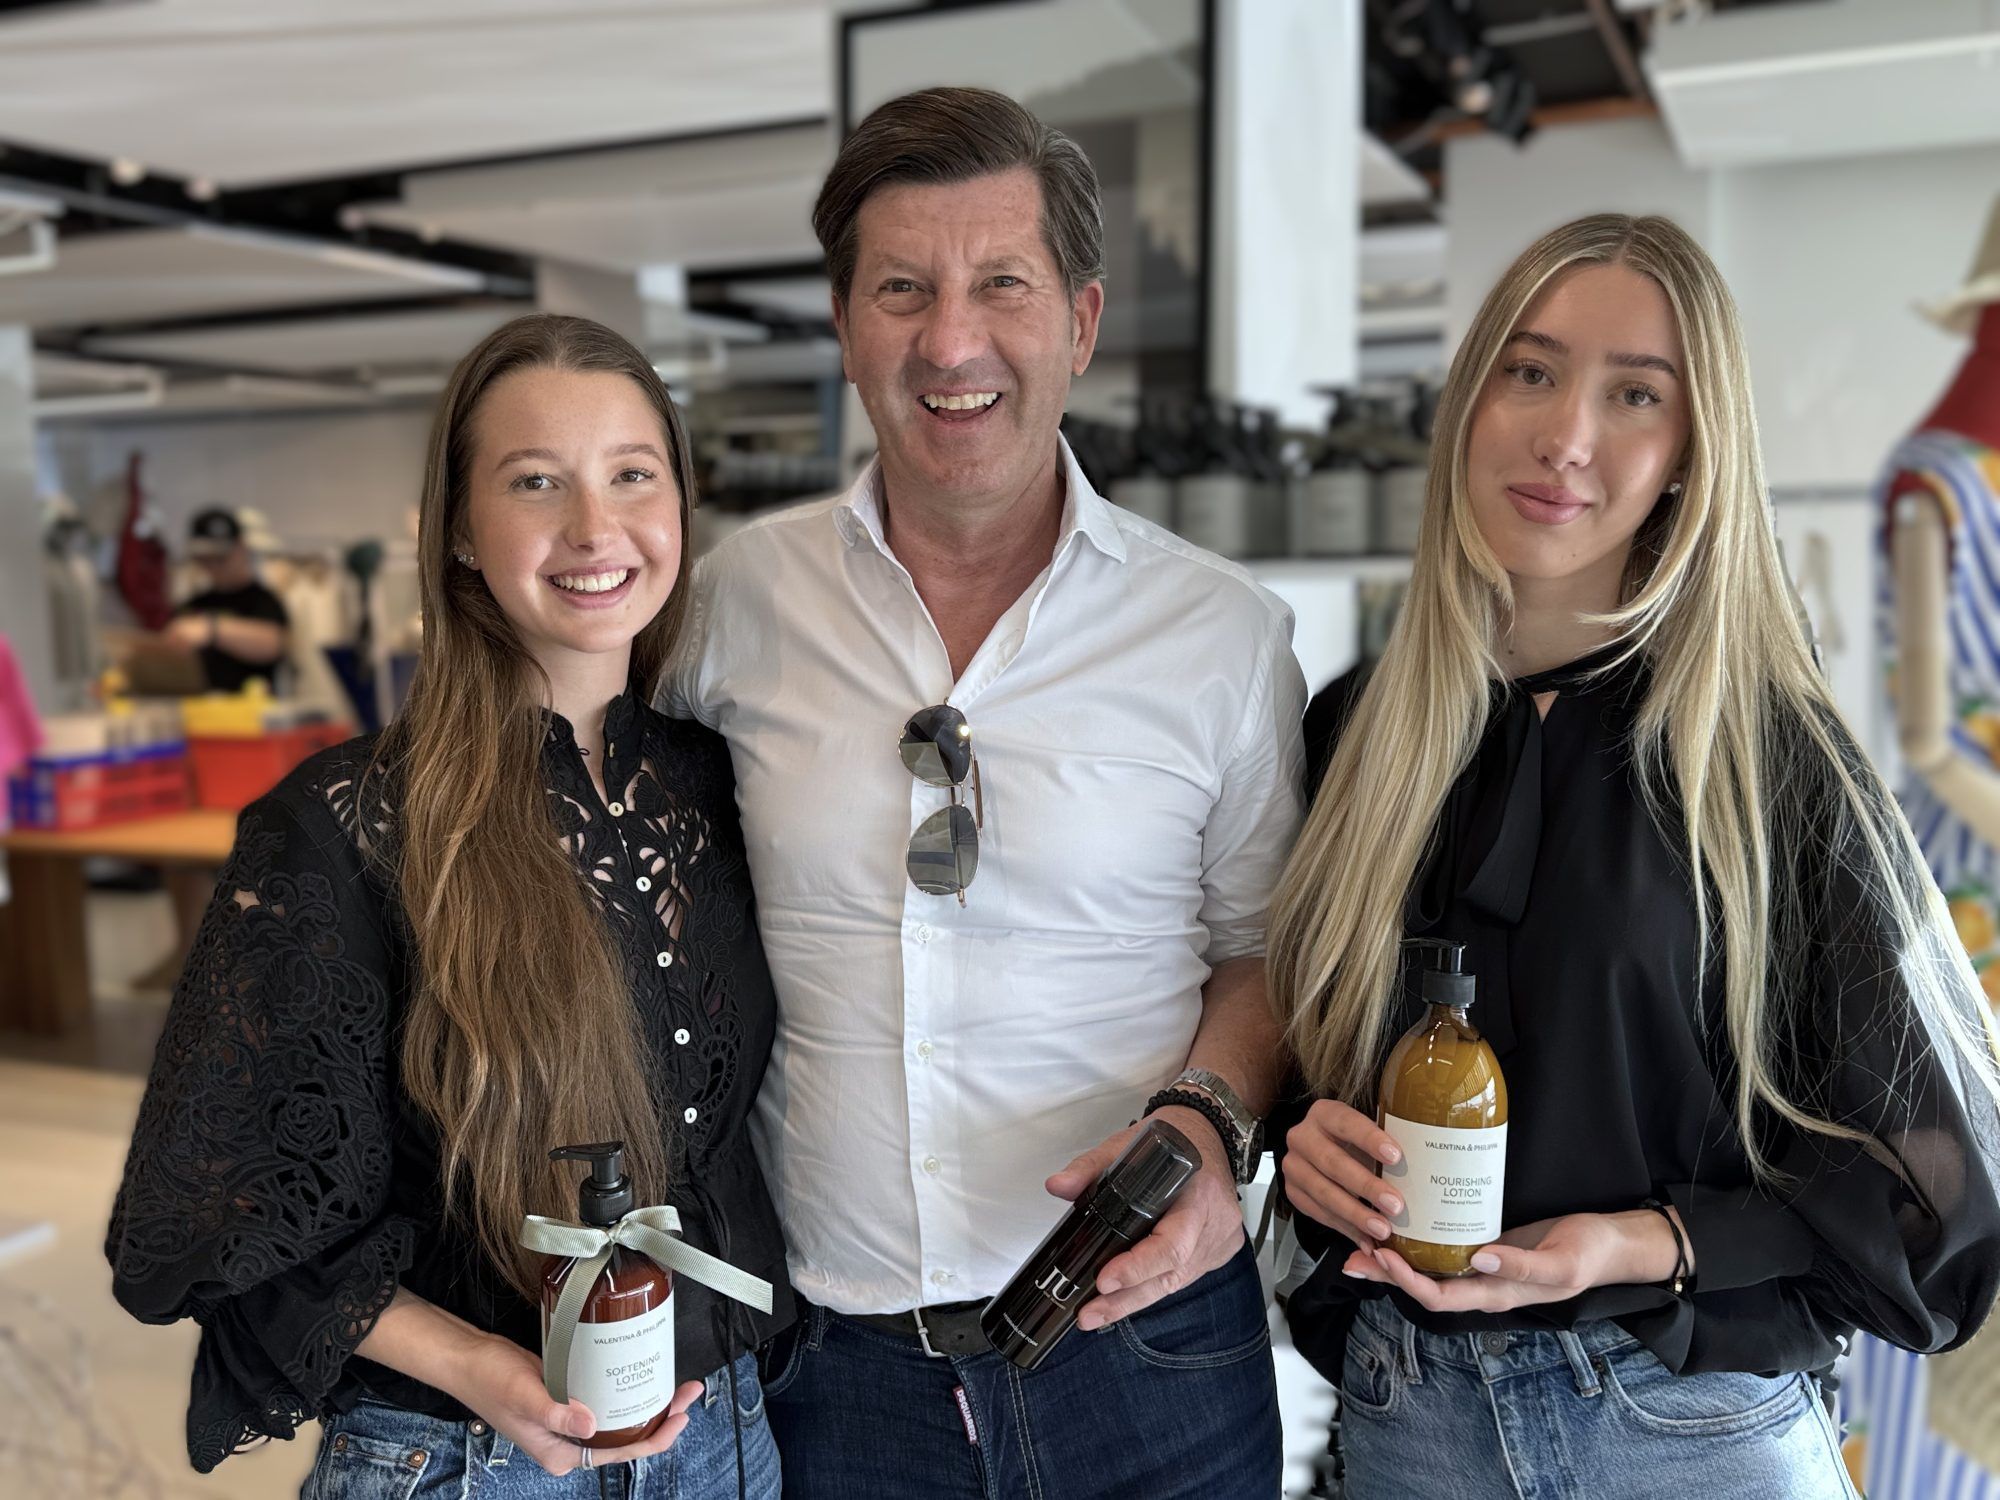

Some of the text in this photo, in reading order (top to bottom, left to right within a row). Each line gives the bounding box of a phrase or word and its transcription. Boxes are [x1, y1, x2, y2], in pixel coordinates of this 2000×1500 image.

[1425, 1141, 1466, 1152] VALENTINA
[1467, 1144, 1473, 1152] &
[1430, 1175, 1492, 1187] NOURISHING
[1443, 1188, 1481, 1198] LOTION
[594, 1333, 635, 1345] VALENTINA
[636, 1329, 642, 1337] &
[605, 1352, 661, 1378] SOFTENING
[616, 1366, 654, 1386] LOTION
[956, 1388, 977, 1442] DSQUARED2
